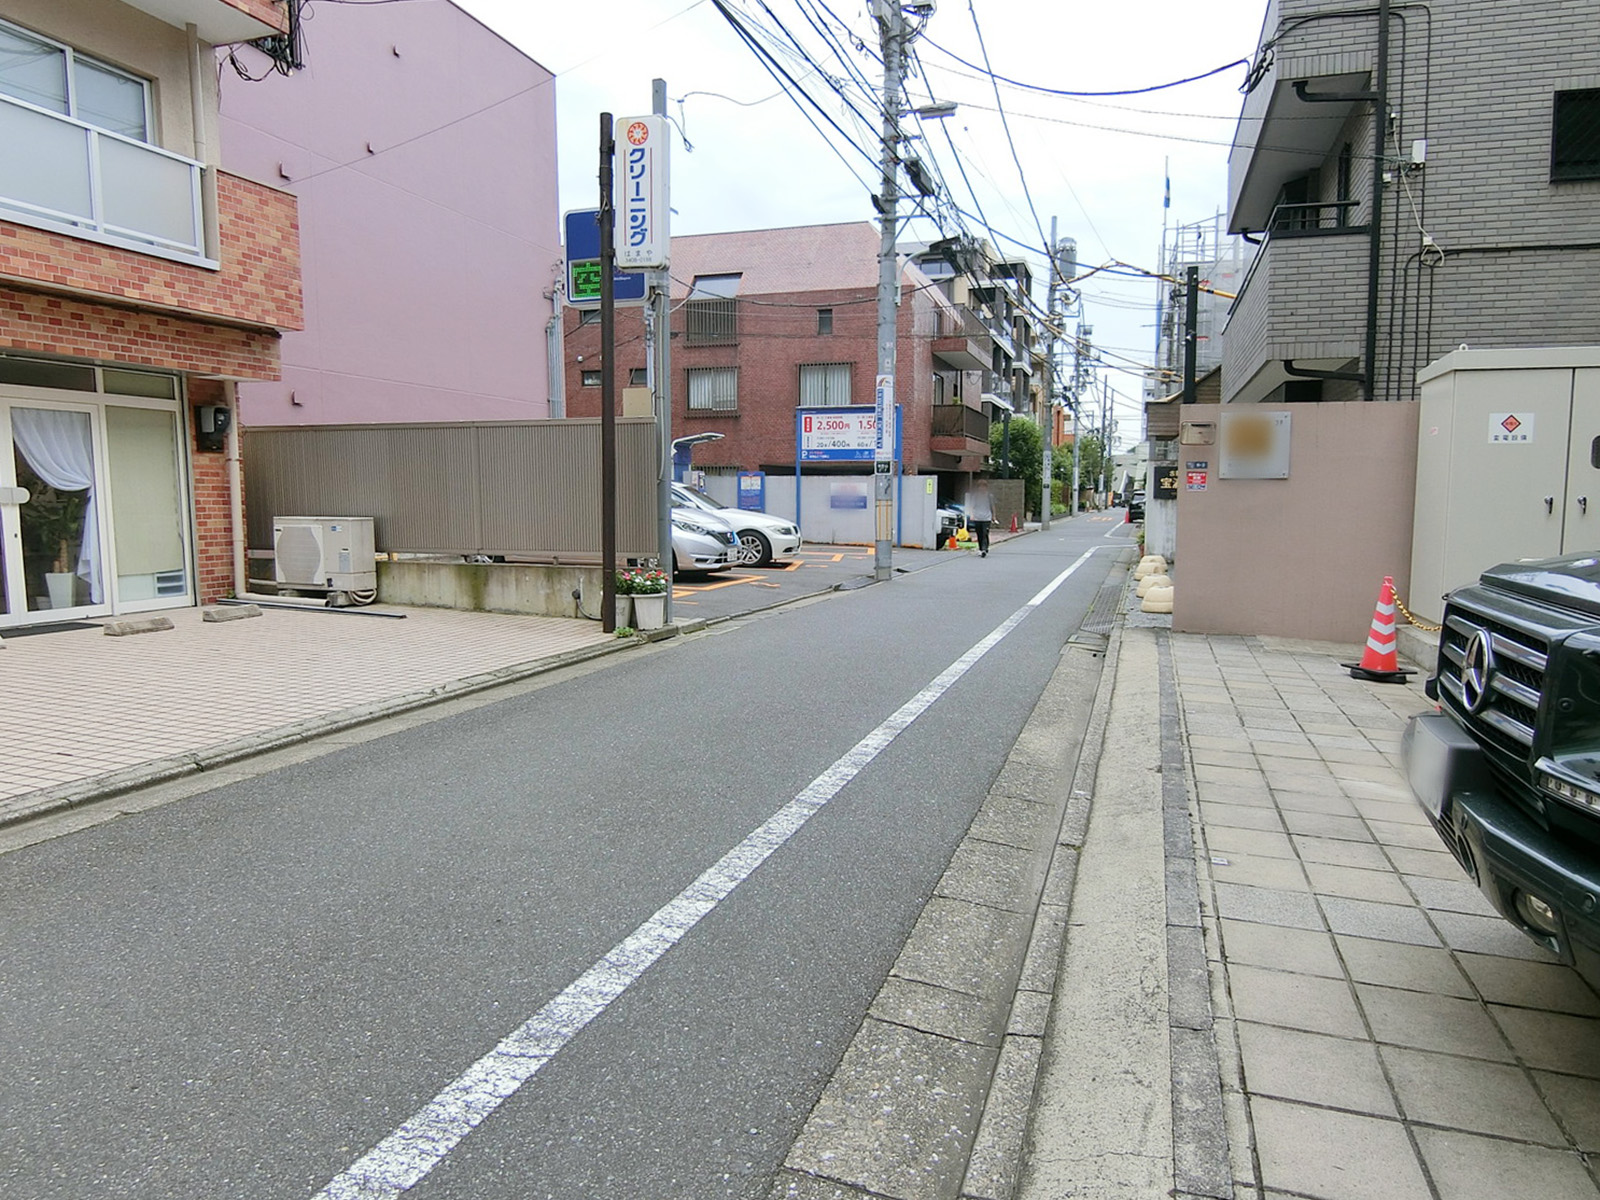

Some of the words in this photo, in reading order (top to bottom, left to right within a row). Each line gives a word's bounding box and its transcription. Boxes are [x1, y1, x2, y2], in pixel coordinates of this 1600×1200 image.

[630, 147, 648, 247] クリーニング
